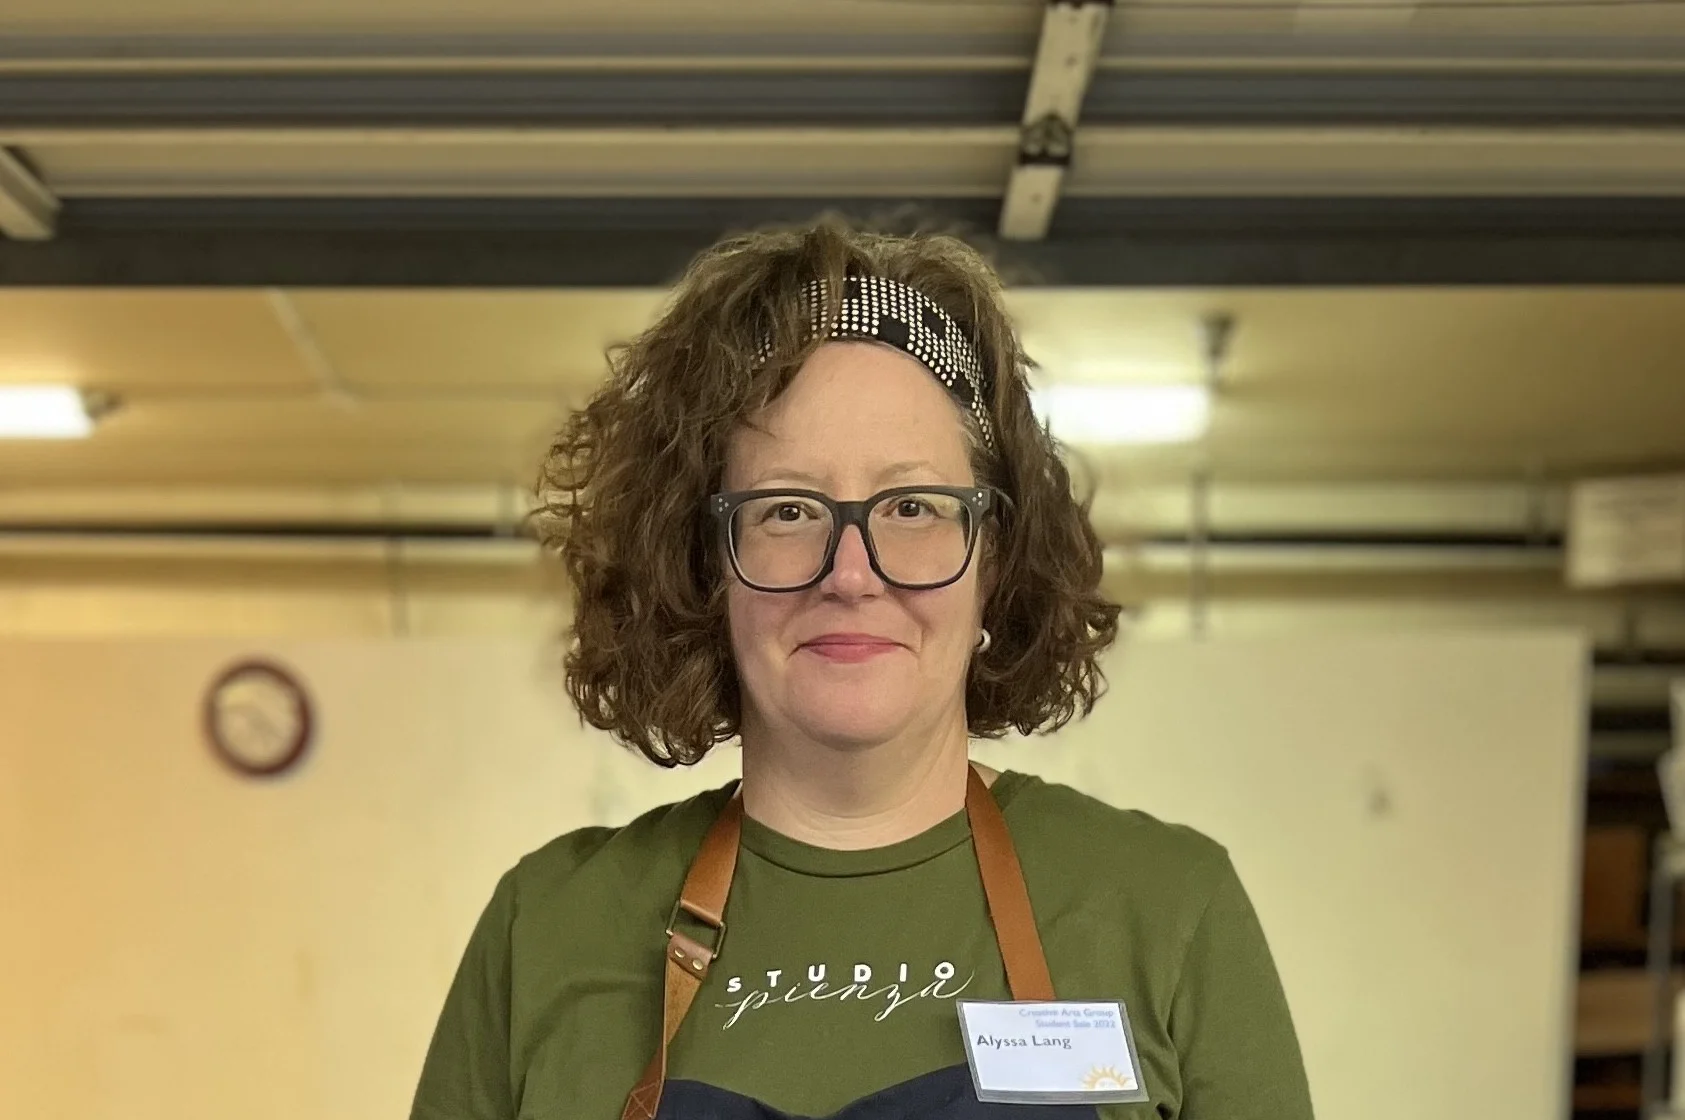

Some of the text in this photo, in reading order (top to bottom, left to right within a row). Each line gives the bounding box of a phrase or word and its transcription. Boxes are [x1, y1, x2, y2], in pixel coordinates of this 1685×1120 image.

[726, 961, 955, 993] STUDIO
[714, 967, 976, 1031] pienza
[1019, 1008, 1114, 1018] Creative Arts Group
[1035, 1019, 1070, 1028] Student
[976, 1034, 1072, 1050] Alyssa Lang
